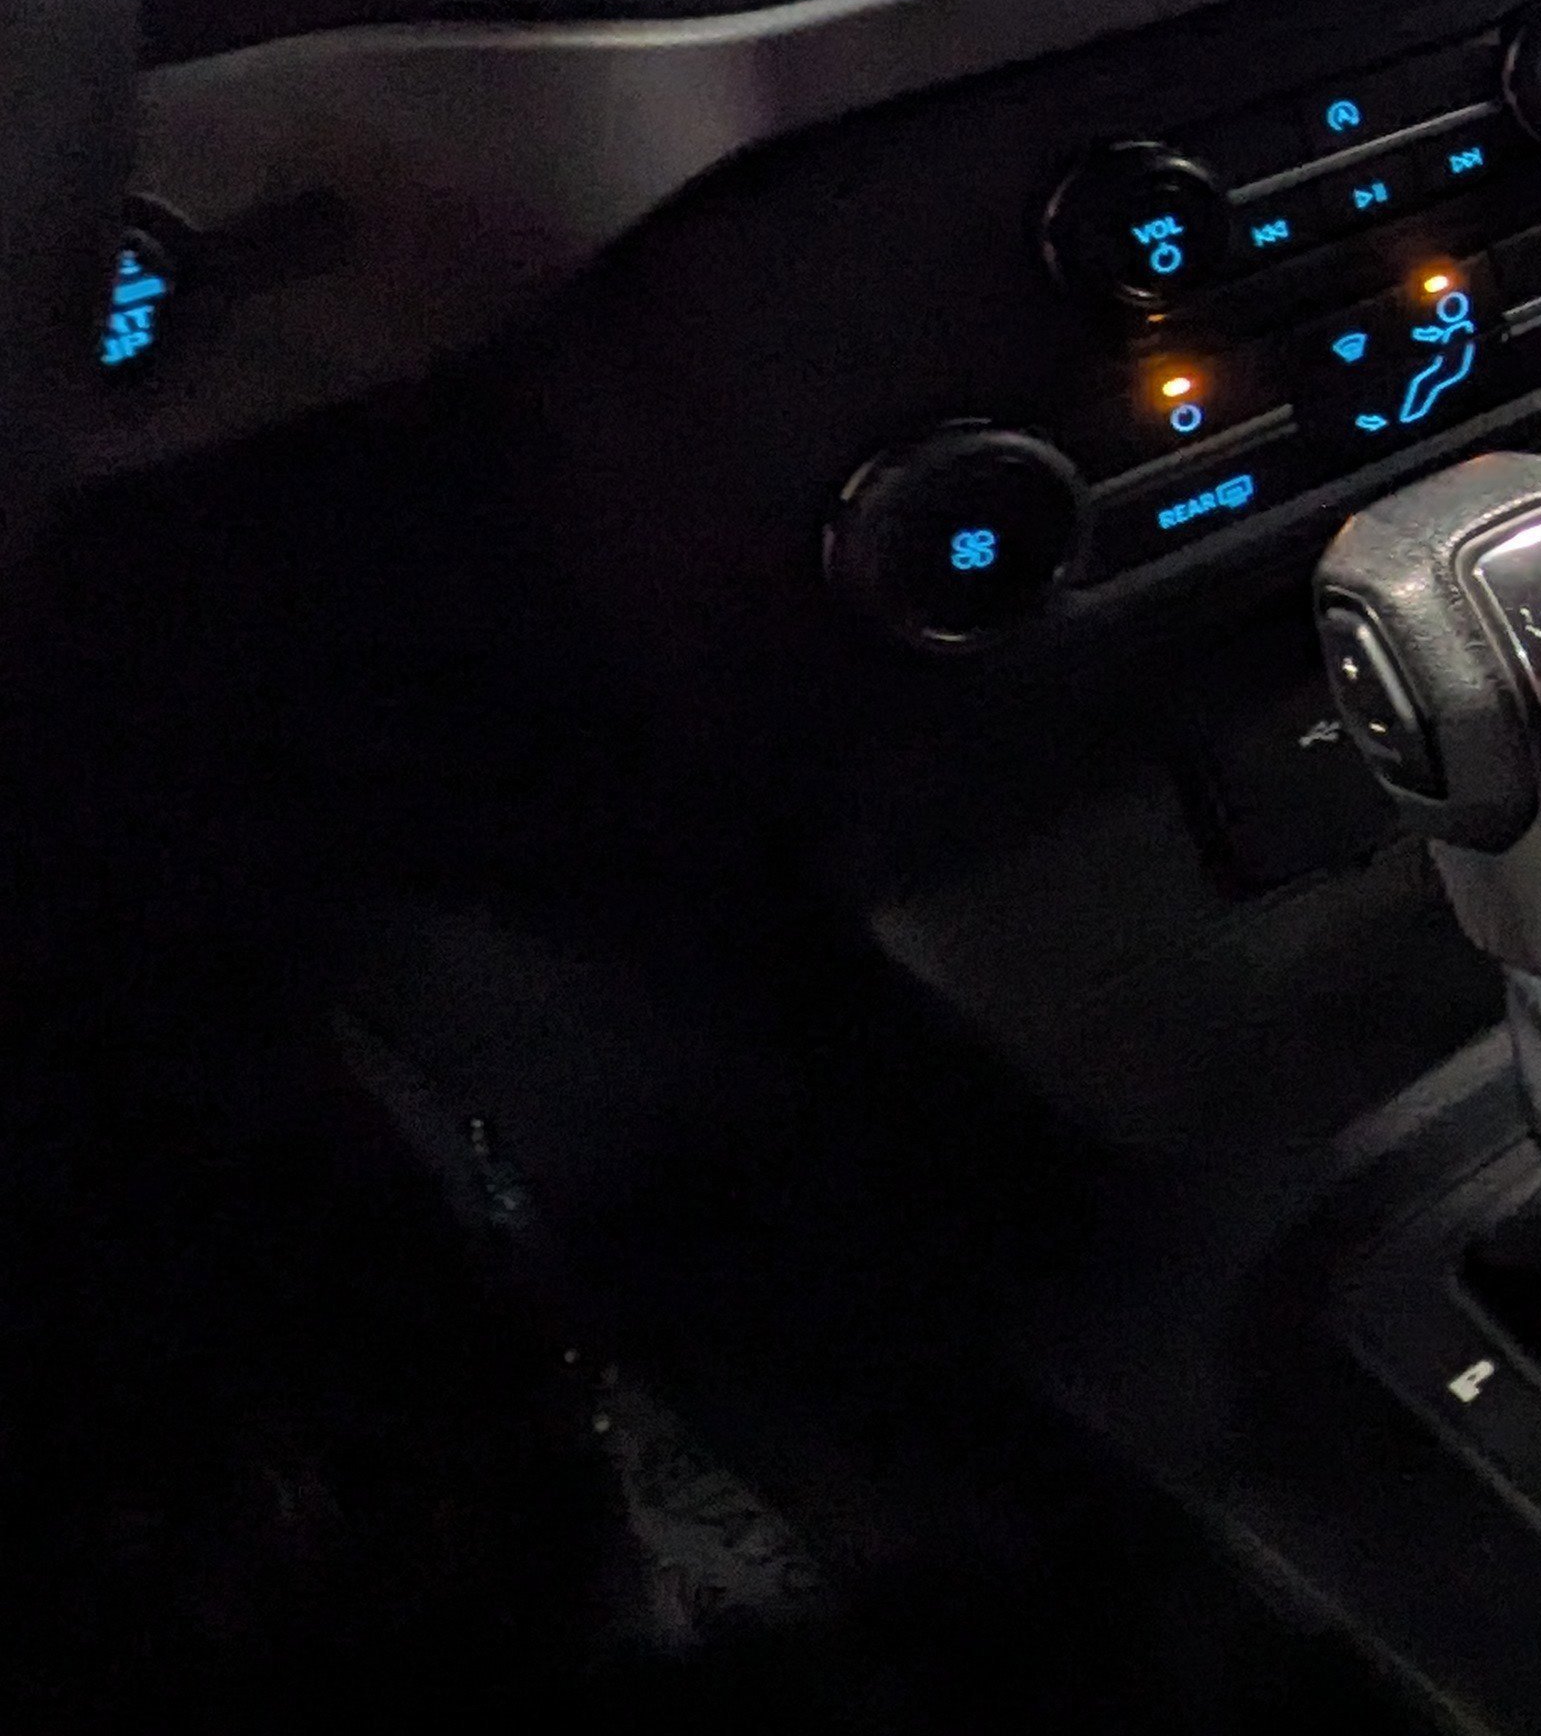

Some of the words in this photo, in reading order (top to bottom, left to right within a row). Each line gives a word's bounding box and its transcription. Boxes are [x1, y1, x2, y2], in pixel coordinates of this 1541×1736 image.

[1131, 215, 1185, 244] VOL
[1158, 491, 1217, 531] REAR
[1447, 1360, 1494, 1403] P
